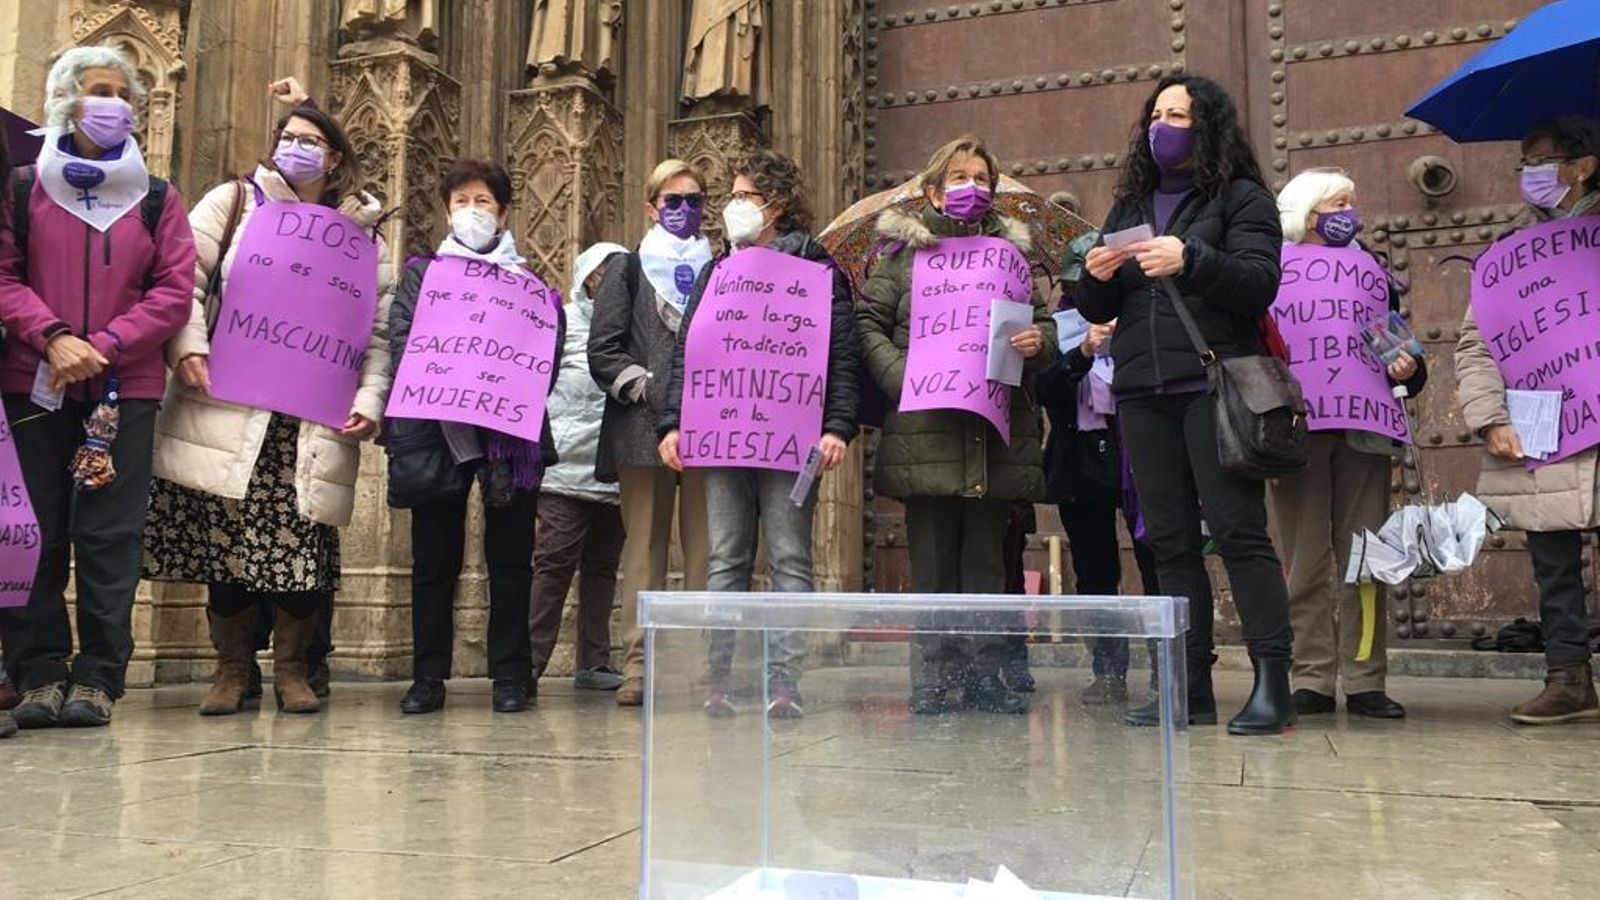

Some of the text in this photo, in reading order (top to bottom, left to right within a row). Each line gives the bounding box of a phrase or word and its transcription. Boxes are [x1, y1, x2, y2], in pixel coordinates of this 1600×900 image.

[276, 211, 362, 260] DIOS
[249, 253, 362, 298] no es solo
[464, 260, 548, 304] BASTA
[714, 270, 775, 296] Venimos
[786, 280, 808, 298] de
[921, 279, 972, 298] estar
[976, 282, 995, 291] en
[1280, 258, 1388, 302] SOMOS
[1518, 275, 1557, 298] una
[425, 290, 452, 306] que
[459, 292, 478, 302] se
[489, 295, 514, 310] nos
[469, 311, 487, 324] el
[1274, 299, 1375, 326] MUJERE
[716, 303, 817, 333] una larga
[916, 305, 991, 340] IGLE
[1491, 290, 1600, 362] IGLESI
[228, 309, 367, 373] MASCULINO
[407, 335, 552, 375] SACERDOCIO
[722, 332, 807, 357] tradición
[1286, 335, 1381, 374] LIBRES
[476, 370, 507, 384] ser
[690, 368, 824, 407] FEMINISTA
[910, 369, 961, 397] VOZ
[401, 384, 529, 423] MUJERES
[720, 404, 769, 422] en la
[1302, 395, 1408, 437] ALIENTES
[682, 430, 800, 465] IGLESIA
